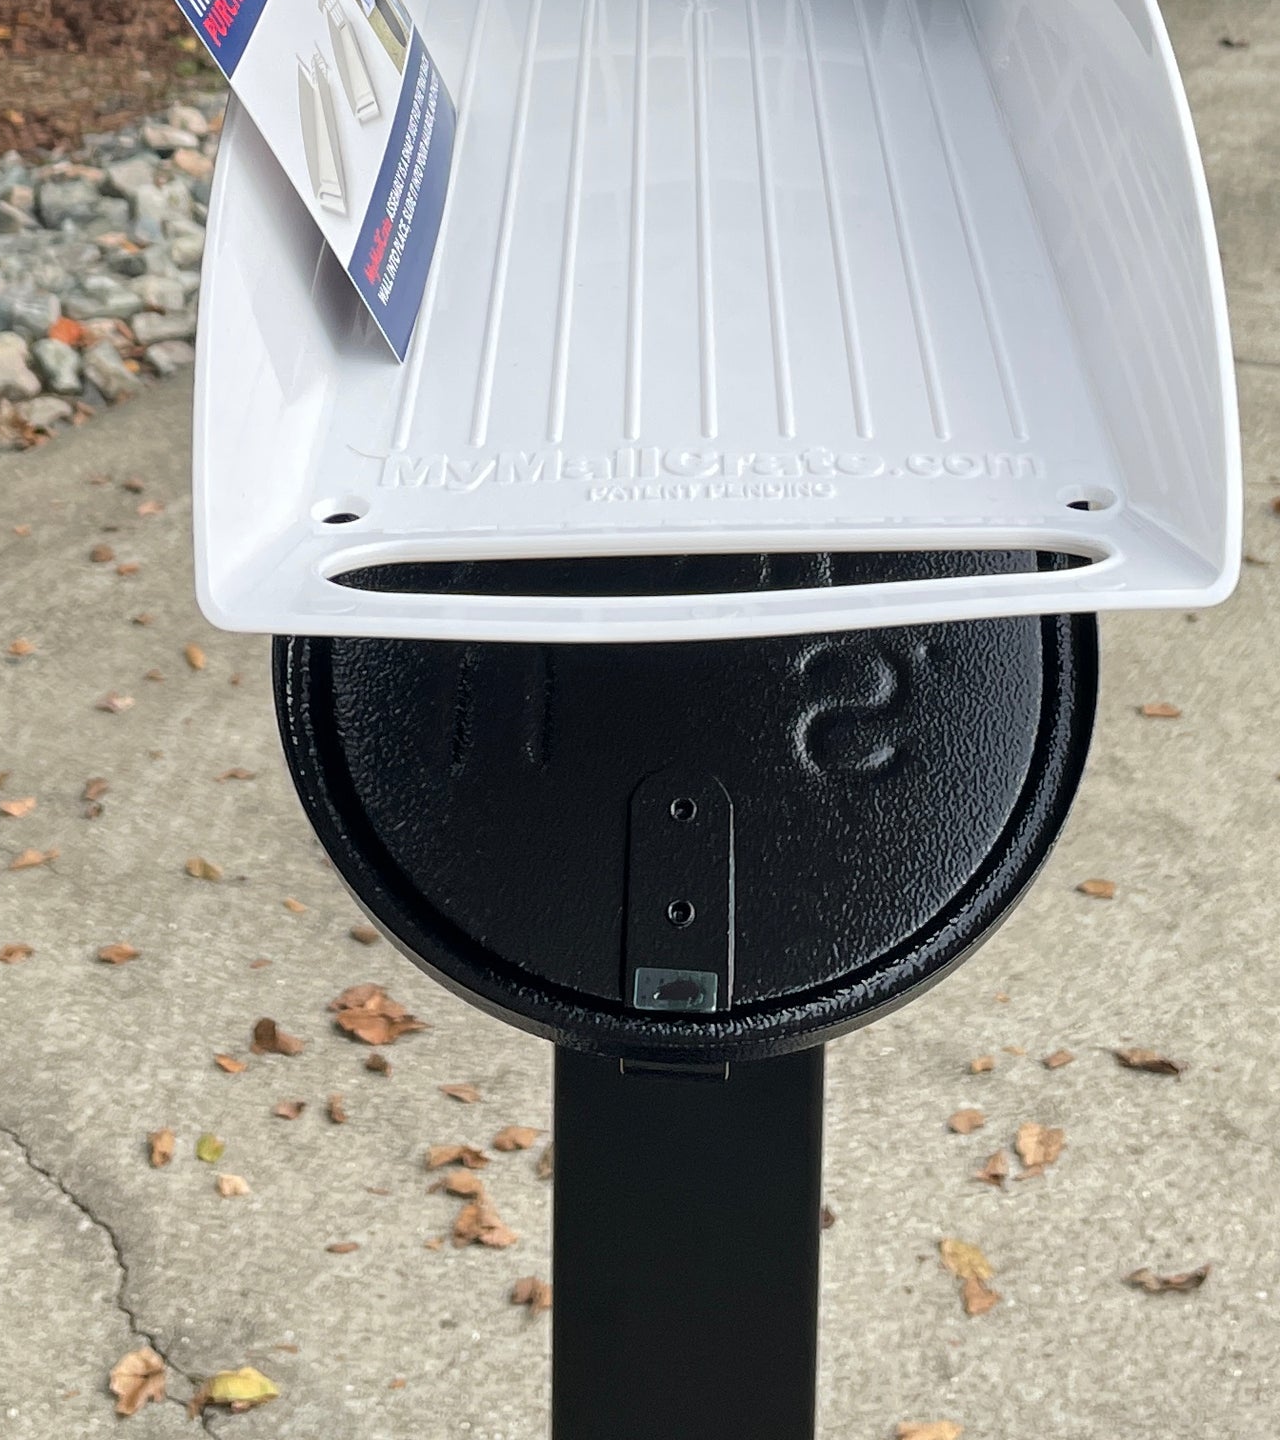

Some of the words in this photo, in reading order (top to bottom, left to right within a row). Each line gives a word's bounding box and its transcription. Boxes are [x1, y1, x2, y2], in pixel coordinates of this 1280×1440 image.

[411, 163, 424, 192] INTO
[386, 168, 405, 223] ASSEMBLY
[402, 191, 416, 224] SLIDE
[393, 218, 412, 256] PLACE,
[386, 250, 401, 278] INTO
[377, 273, 393, 306] WALL
[377, 446, 1046, 492] MyMailCrate.com
[586, 484, 697, 502] PATENT
[704, 482, 838, 500] PENDING
